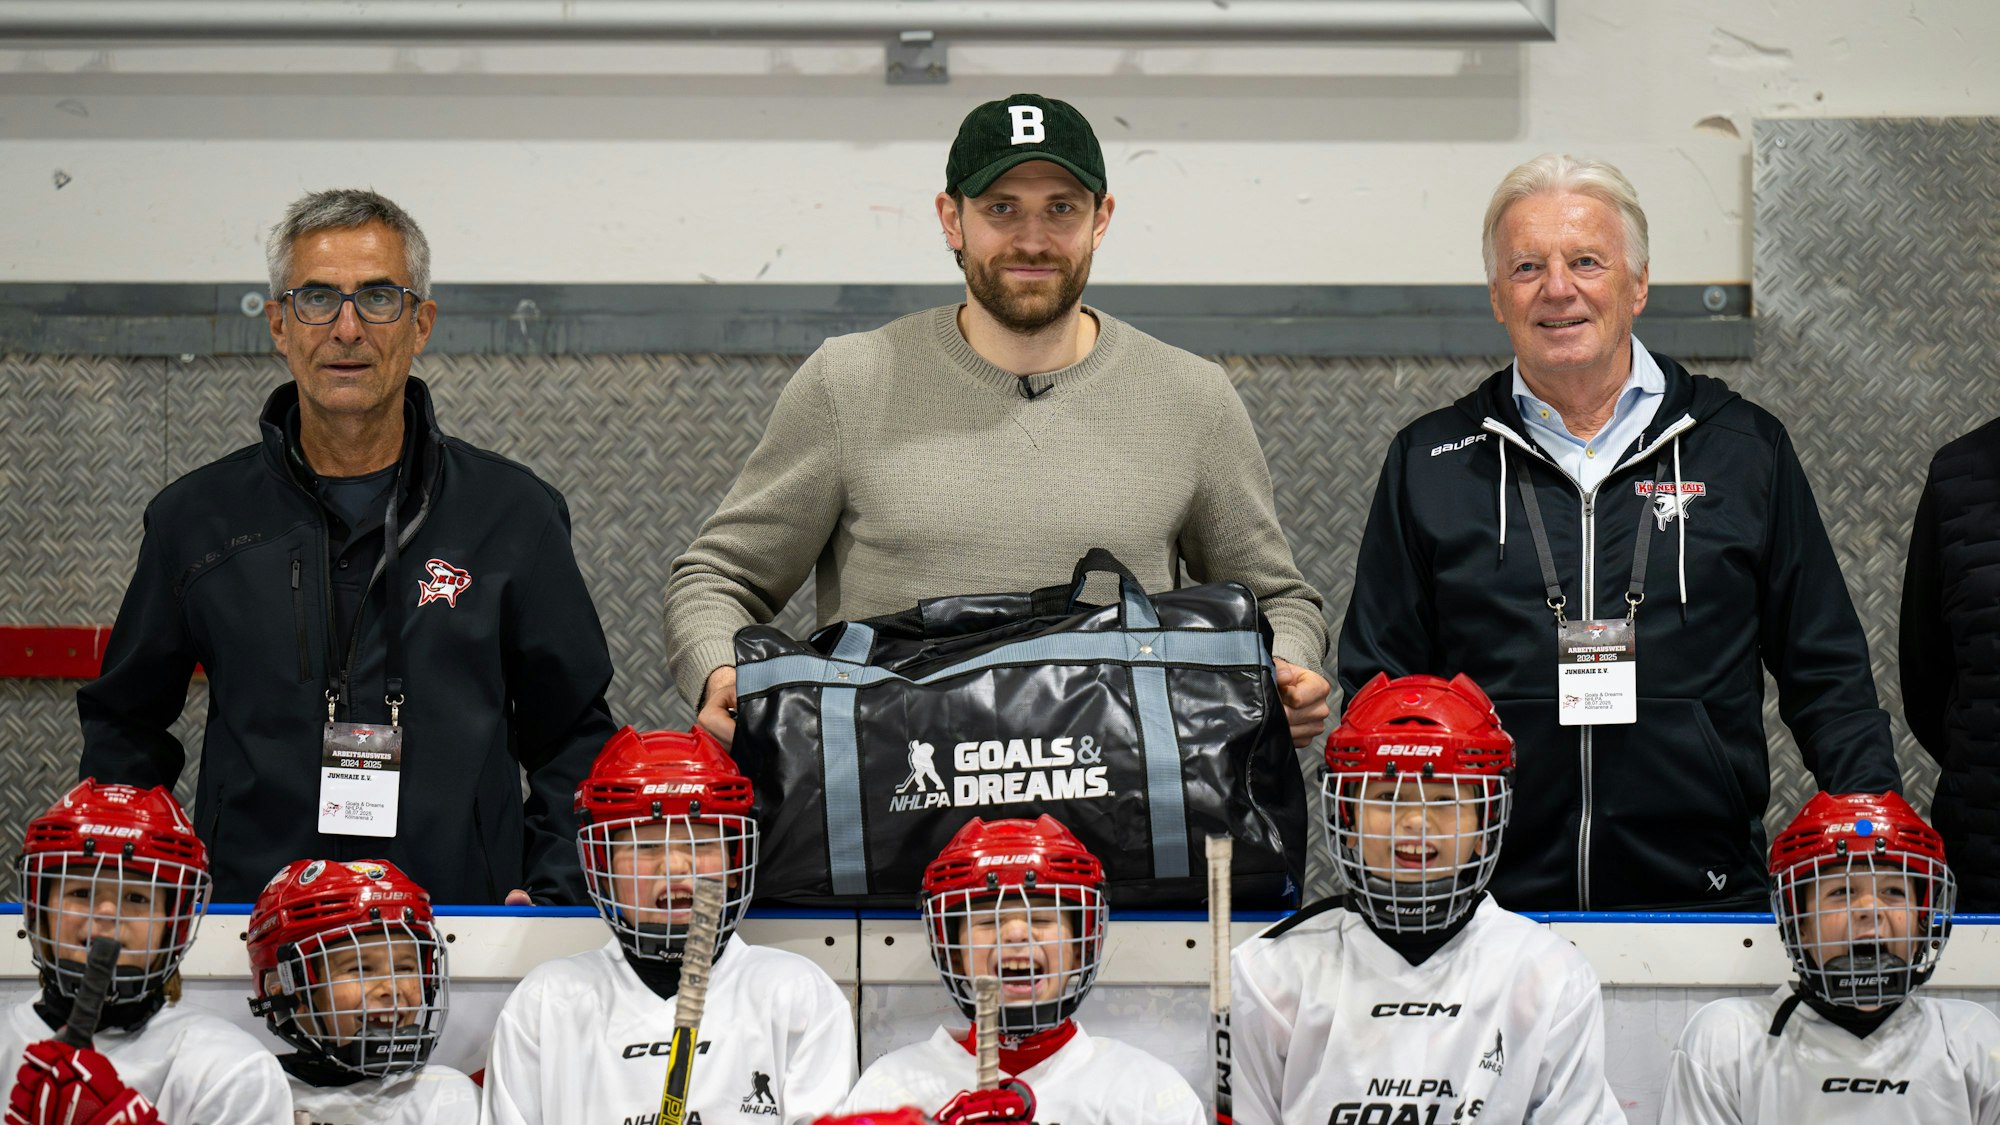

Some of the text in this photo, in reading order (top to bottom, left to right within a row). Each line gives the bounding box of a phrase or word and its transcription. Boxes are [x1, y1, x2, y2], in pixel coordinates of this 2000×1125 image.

[1008, 105, 1045, 145] B
[1430, 434, 1487, 457] BAUER
[1568, 645, 1626, 654] ARBEITSAUSWEIS
[332, 750, 391, 760] ARBEITSAUSWEIS
[954, 735, 1102, 771] GOALS &
[1376, 744, 1443, 757] BAUER
[642, 784, 705, 794] BAUER
[954, 766, 1109, 807] DREAMS
[889, 791, 951, 812] NHLPA
[78, 823, 143, 838] BAUER
[978, 854, 1041, 867] BAUER
[360, 891, 413, 901] BAUER
[1838, 976, 1890, 988] BAUER
[1371, 1003, 1462, 1017] CCM
[1821, 1078, 1909, 1094] CCM
[740, 1103, 778, 1116] NHLPA
